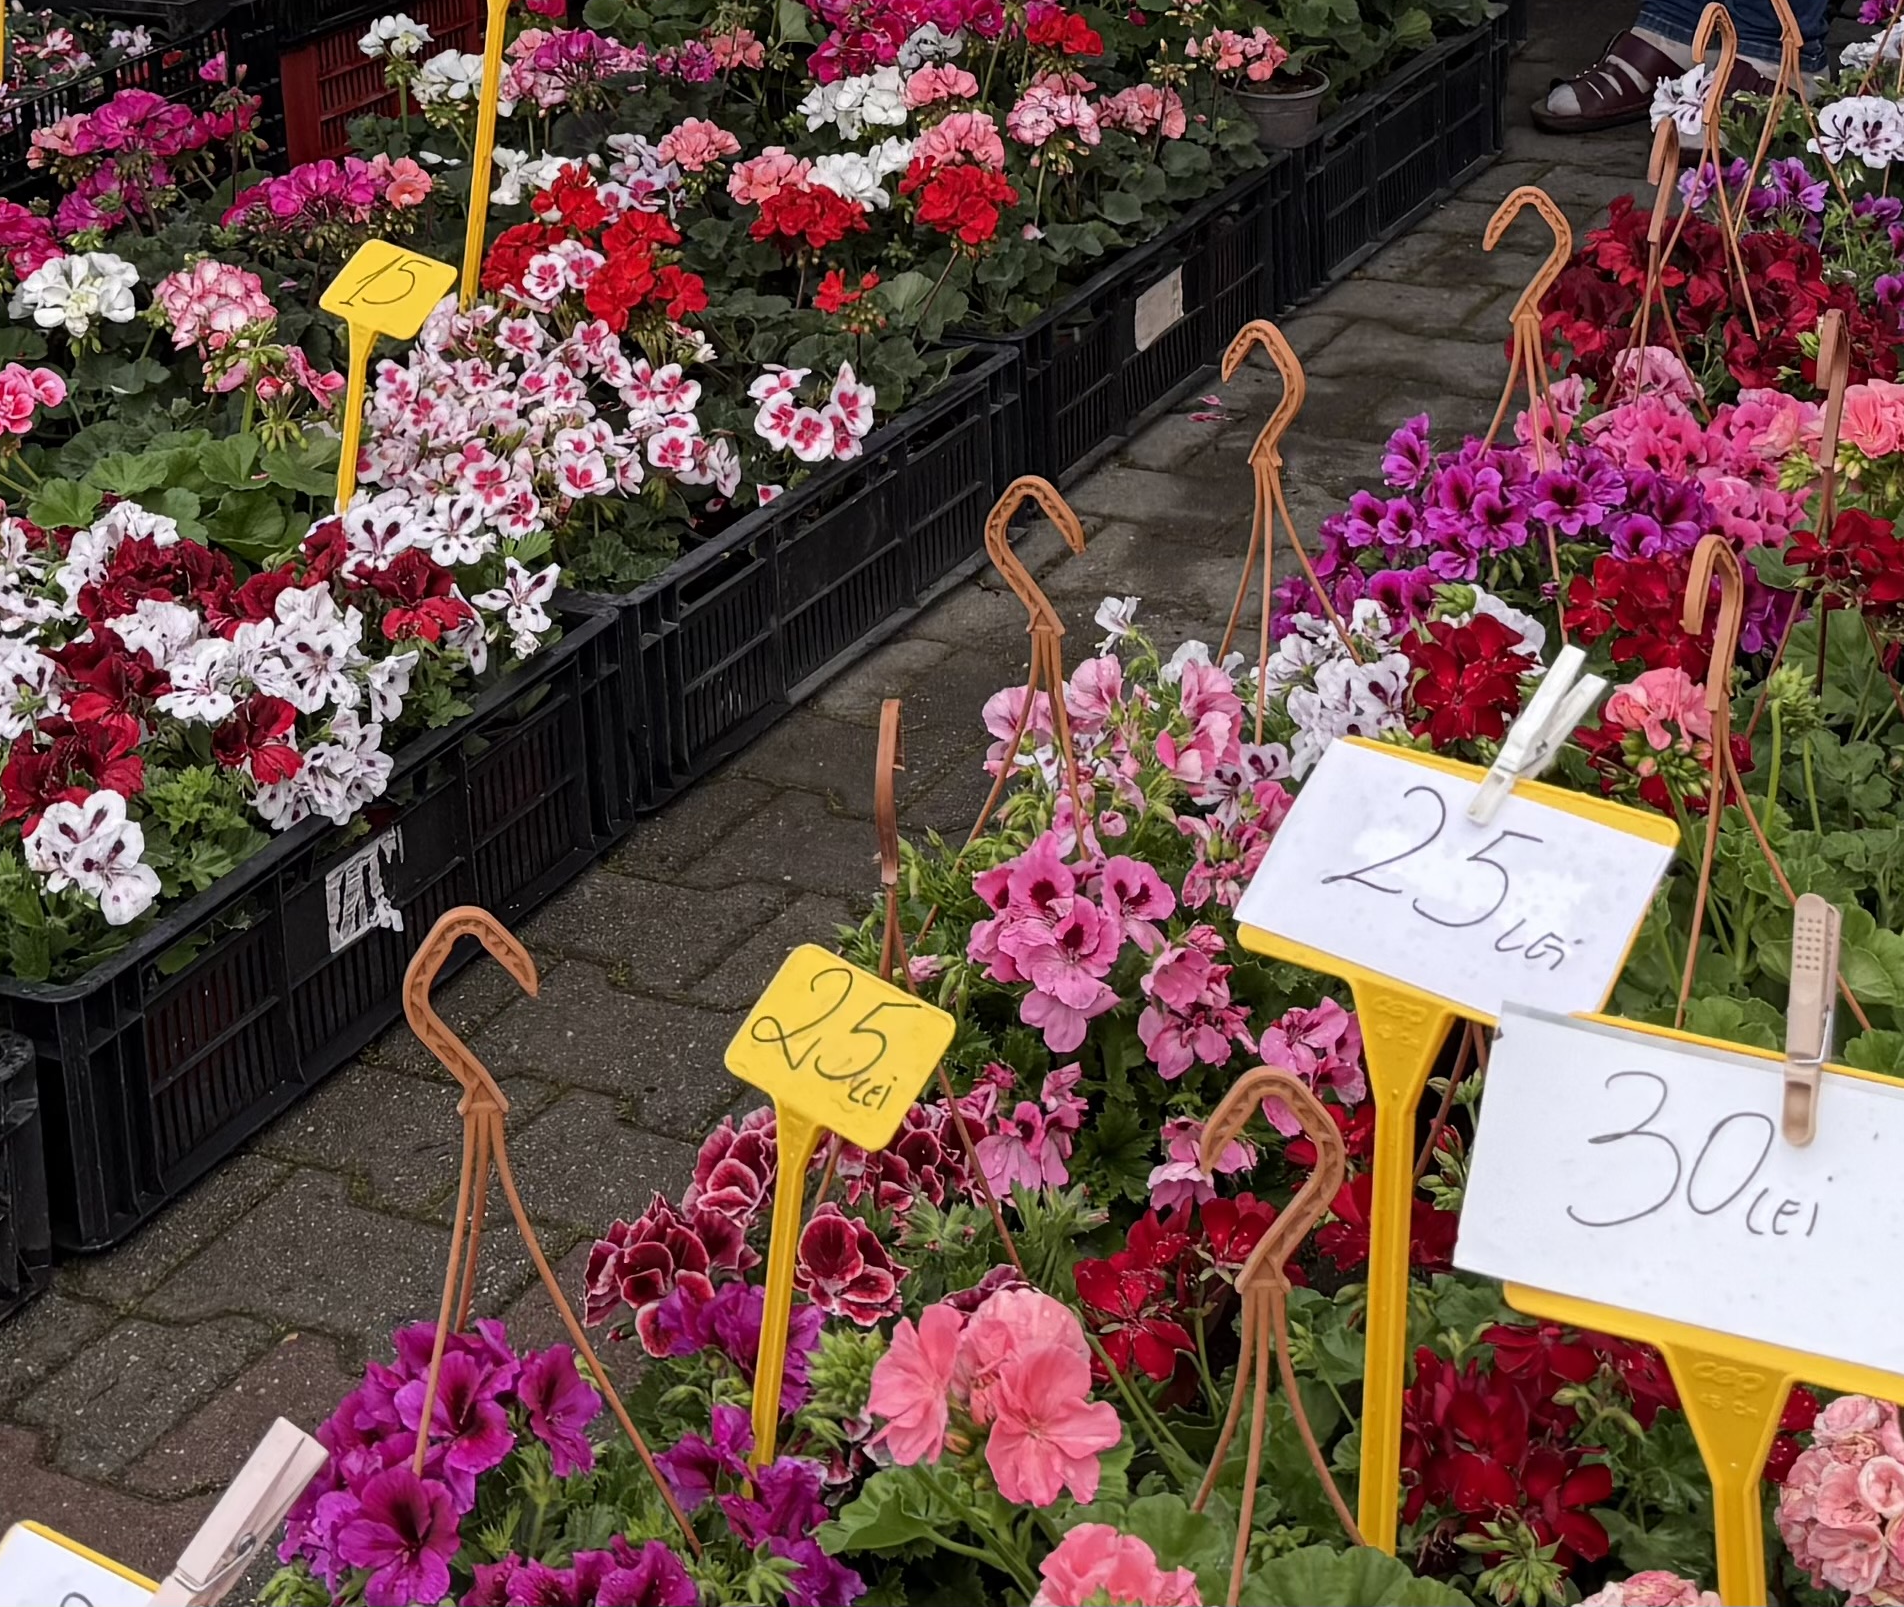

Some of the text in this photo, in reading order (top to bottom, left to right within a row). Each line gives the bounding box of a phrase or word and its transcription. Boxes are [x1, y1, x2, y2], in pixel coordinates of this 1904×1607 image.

[339, 254, 433, 307] 15
[1321, 785, 1545, 928] 25
[751, 967, 924, 1081] 25
[1566, 1070, 1776, 1228] 30
